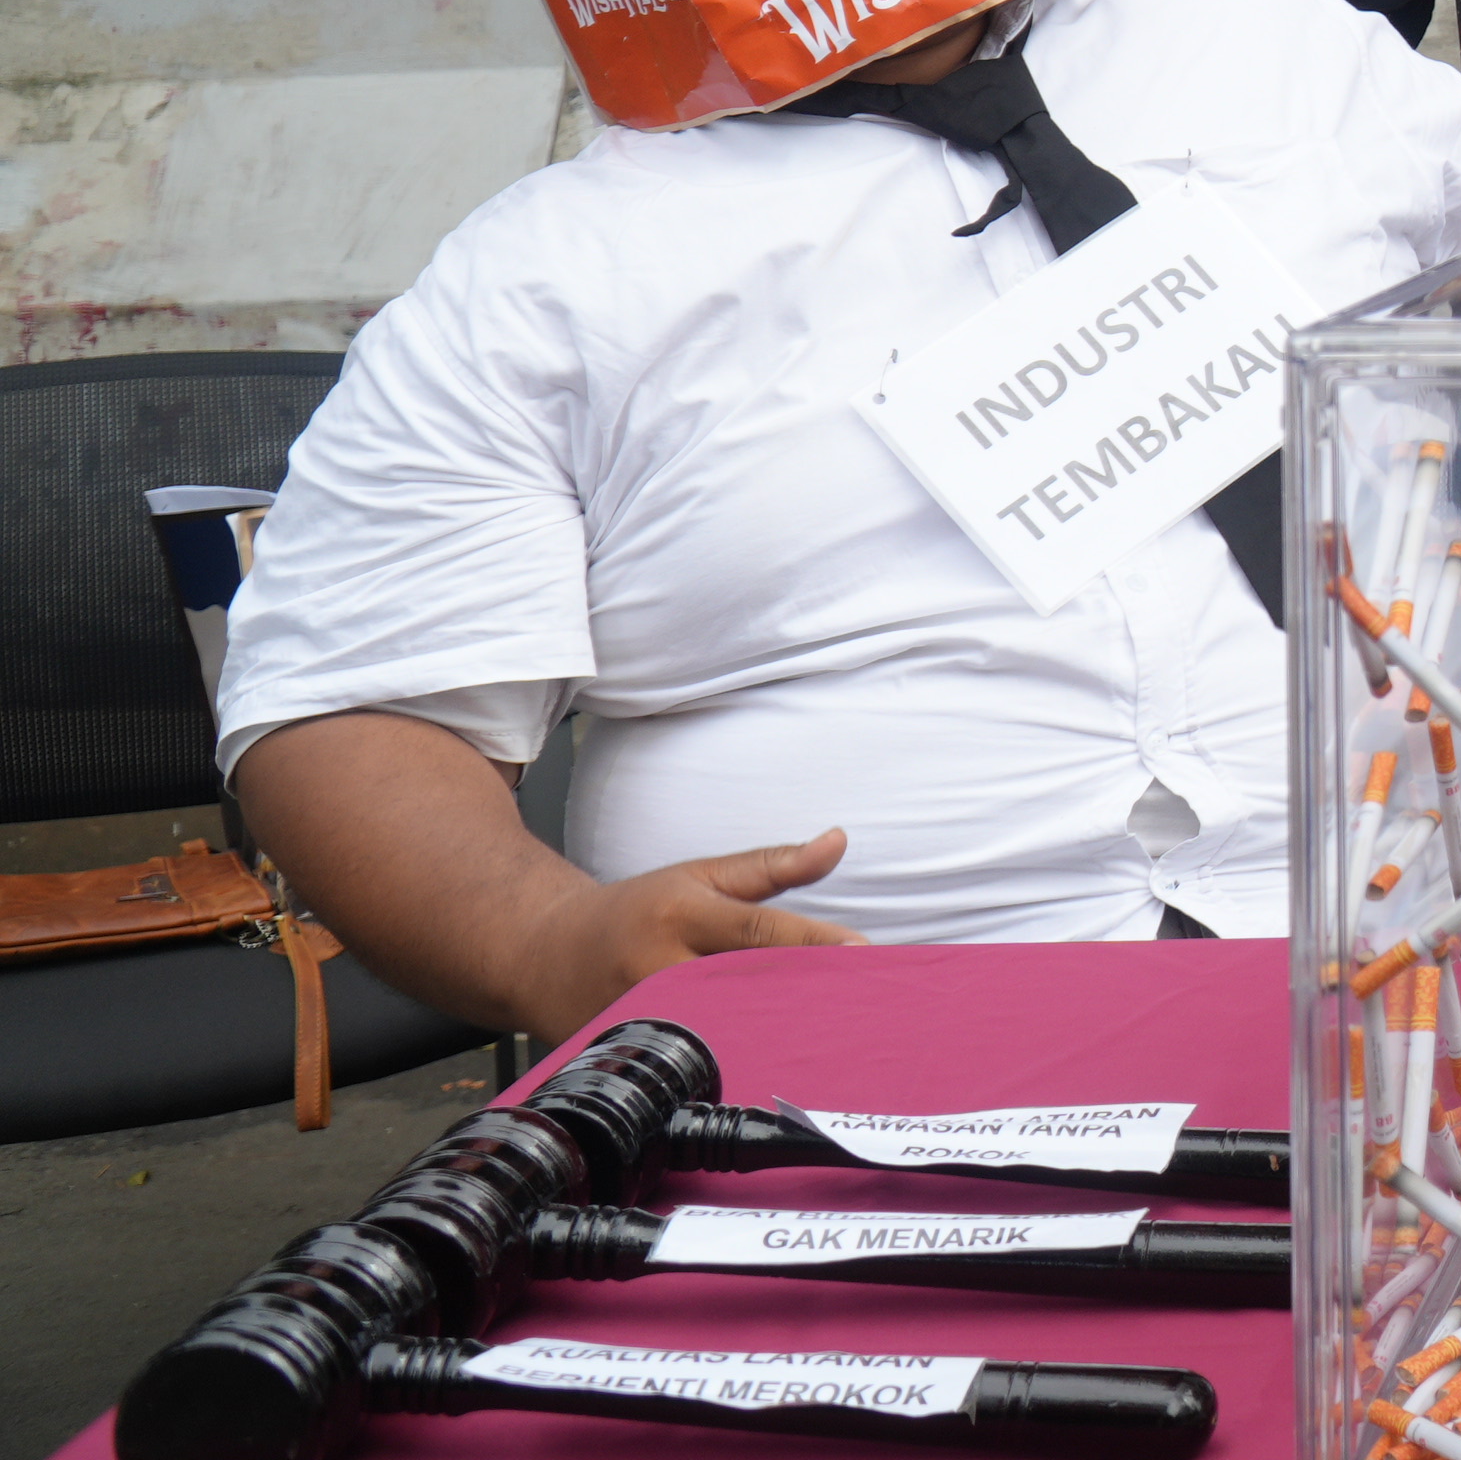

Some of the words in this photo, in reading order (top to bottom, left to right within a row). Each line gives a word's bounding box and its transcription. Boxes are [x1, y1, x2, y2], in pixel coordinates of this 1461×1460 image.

[956, 253, 1219, 450] INDUSTRI
[996, 313, 1298, 541] TEMBAKAU
[1028, 1106, 1163, 1124] ATURAN
[899, 1145, 1033, 1161] ROKOK
[762, 1227, 848, 1251] GAK
[855, 1226, 1035, 1250] MENARIK
[717, 1380, 936, 1408] MEROKOK
